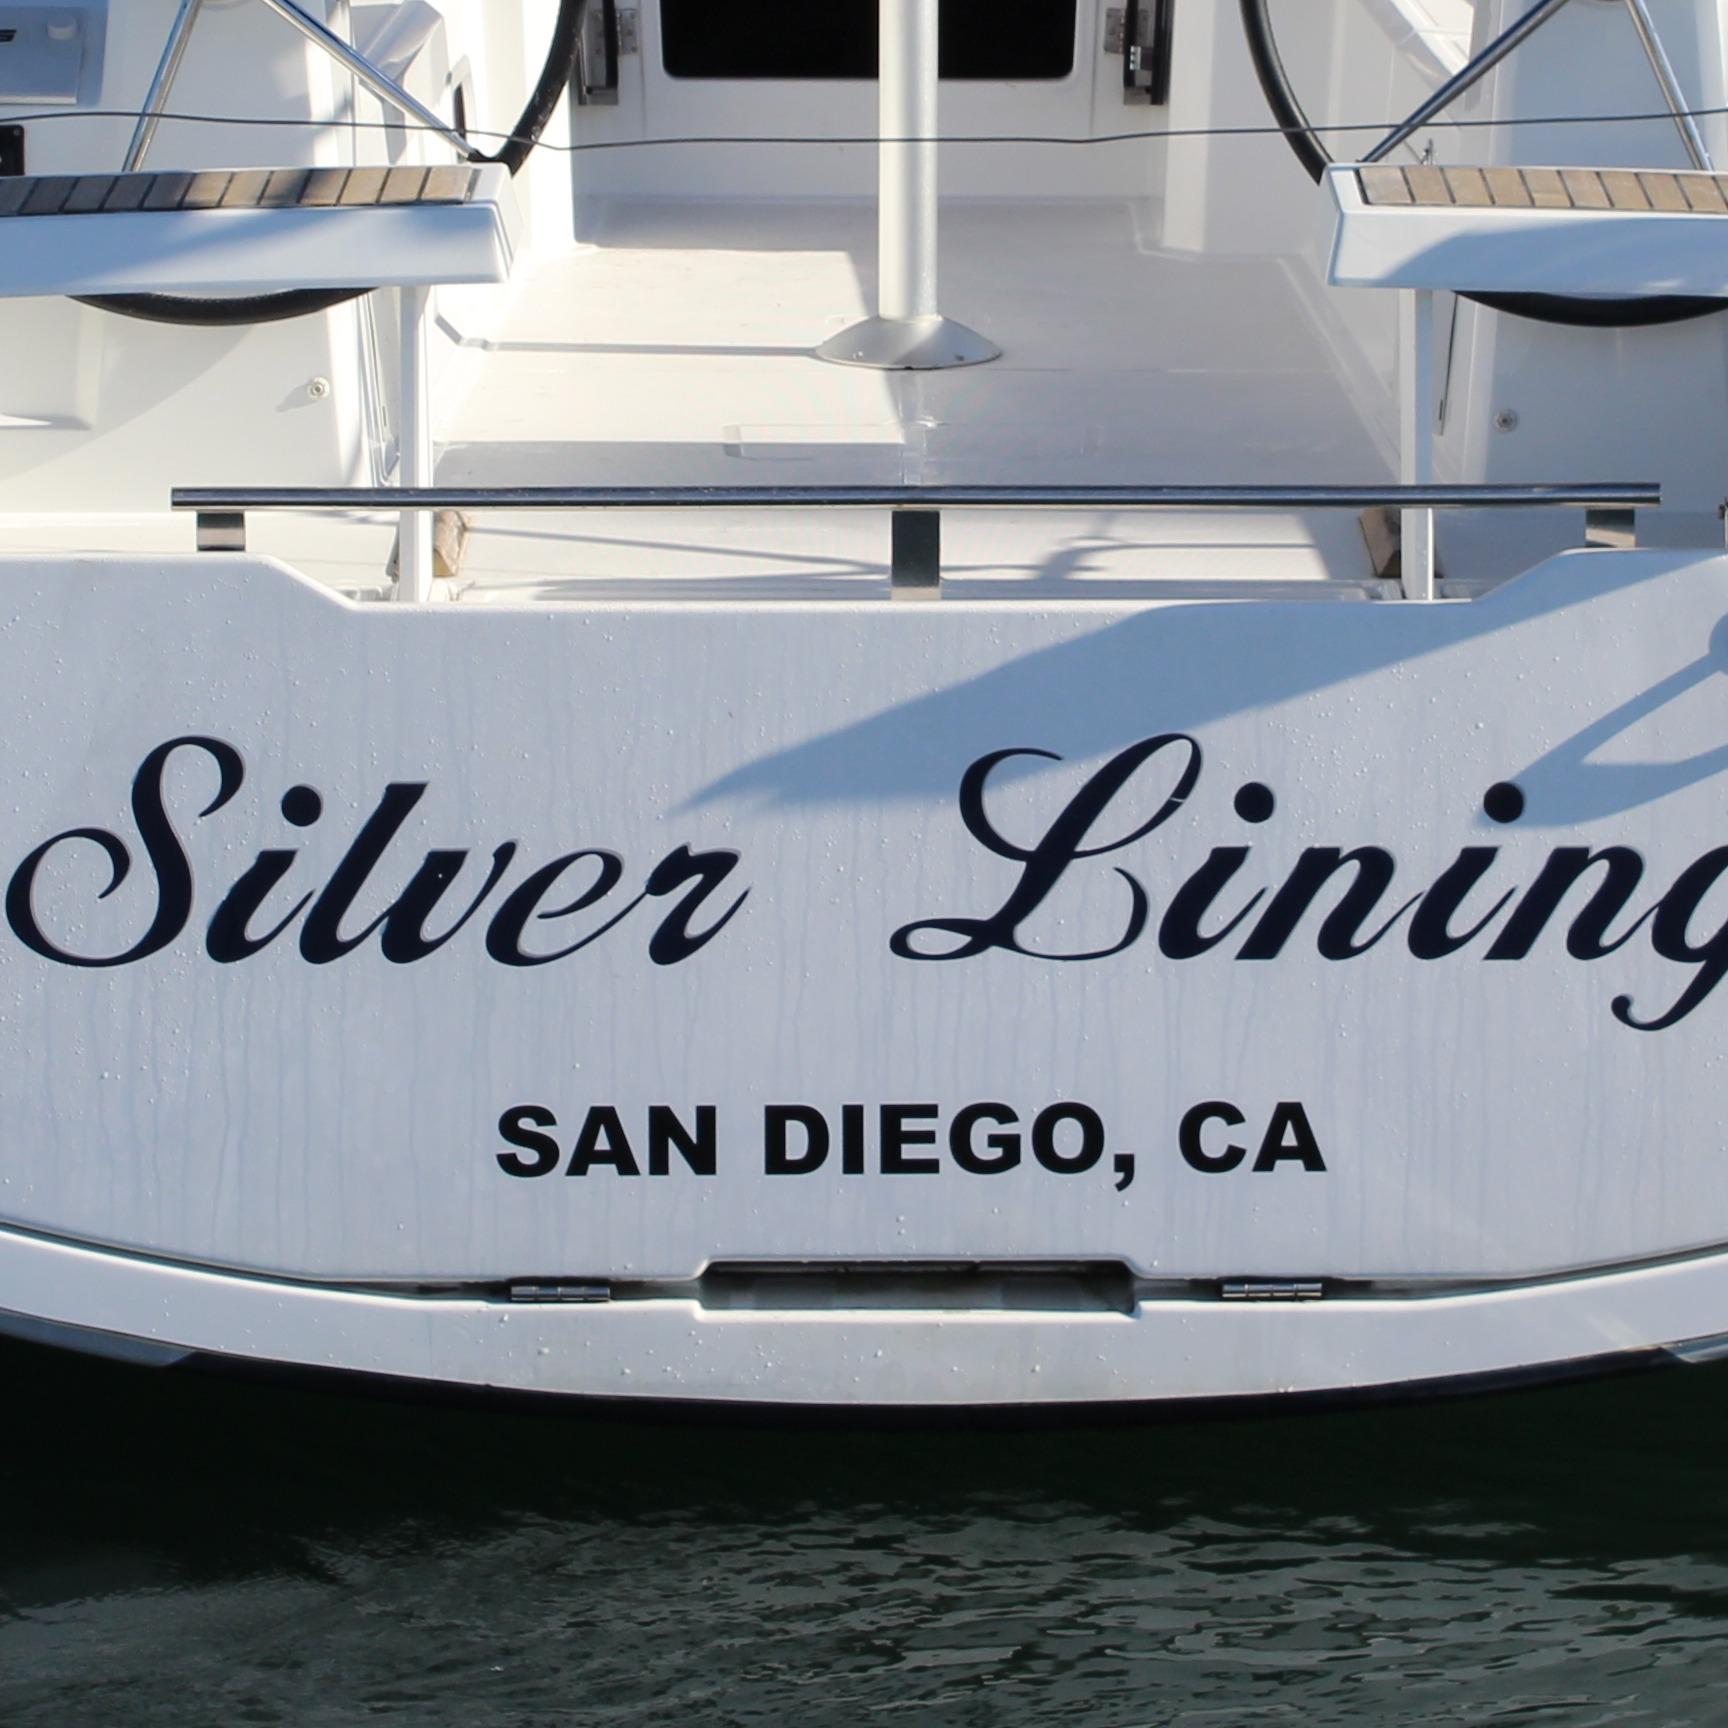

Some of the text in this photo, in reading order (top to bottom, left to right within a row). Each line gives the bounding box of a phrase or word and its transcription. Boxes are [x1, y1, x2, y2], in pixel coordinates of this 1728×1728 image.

[4, 734, 750, 969] Silver
[495, 1100, 1328, 1193] SAN DIEGO, CA
